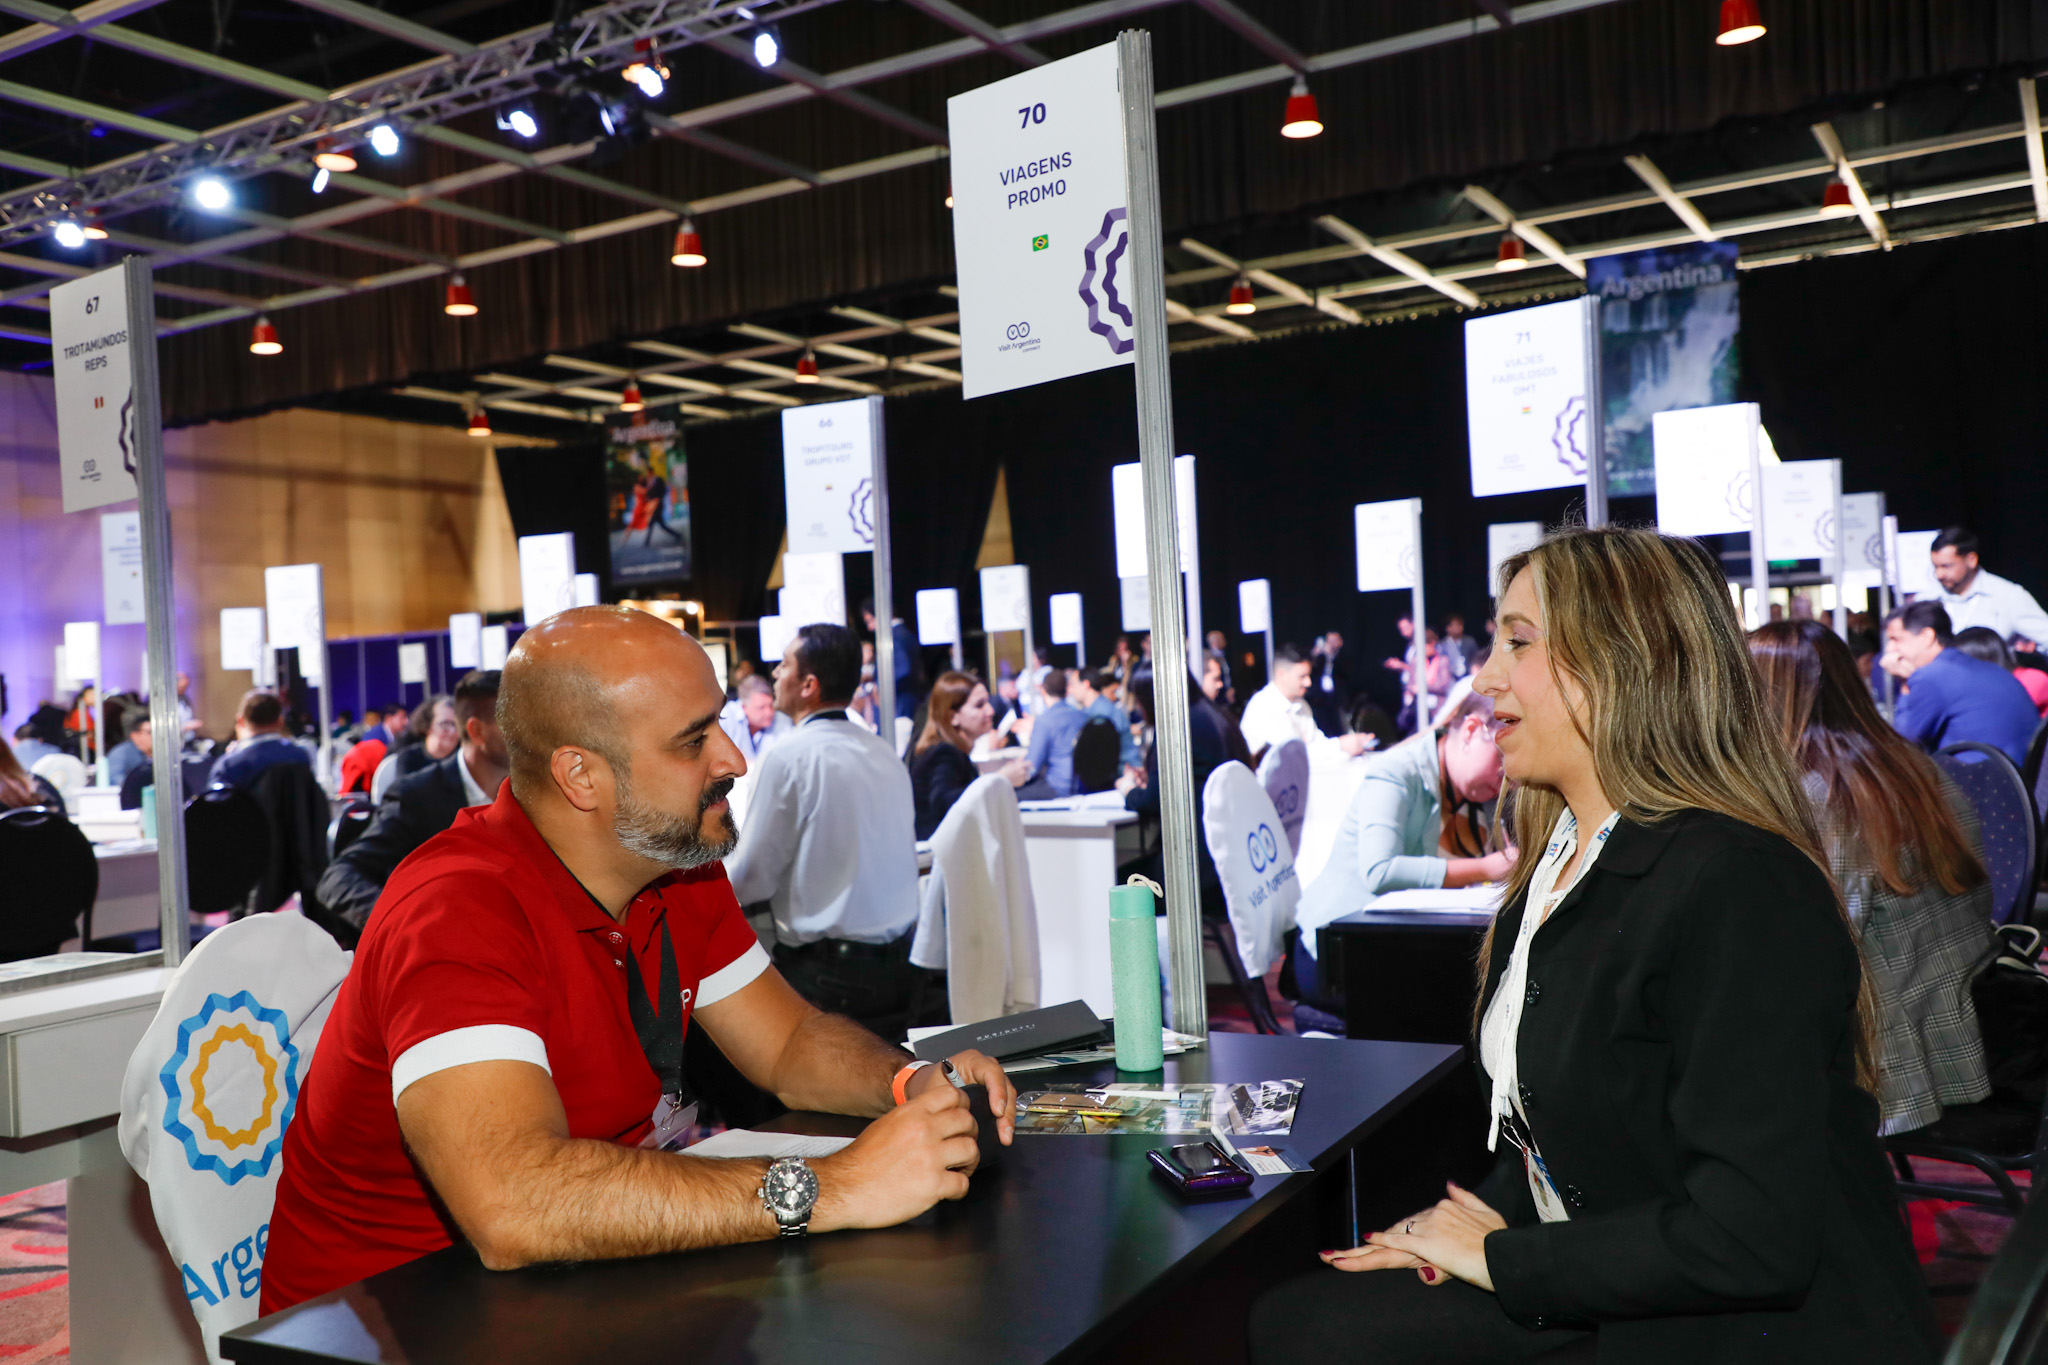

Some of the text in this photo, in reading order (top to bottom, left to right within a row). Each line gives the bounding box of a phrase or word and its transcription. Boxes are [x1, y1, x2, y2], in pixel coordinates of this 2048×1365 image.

[1018, 102, 1047, 129] 70
[999, 151, 1072, 187] VIAGENS
[1007, 179, 1067, 210] PROMO
[1600, 262, 1723, 301] Argentina
[85, 296, 100, 315] 67
[63, 330, 128, 360] TROTAMUNDOS
[998, 338, 1041, 352] Visit Argentina
[1515, 331, 1532, 344] 71
[84, 356, 108, 372] REPS
[1504, 353, 1545, 369] VIAJES
[1491, 365, 1558, 385] FABULOSOS
